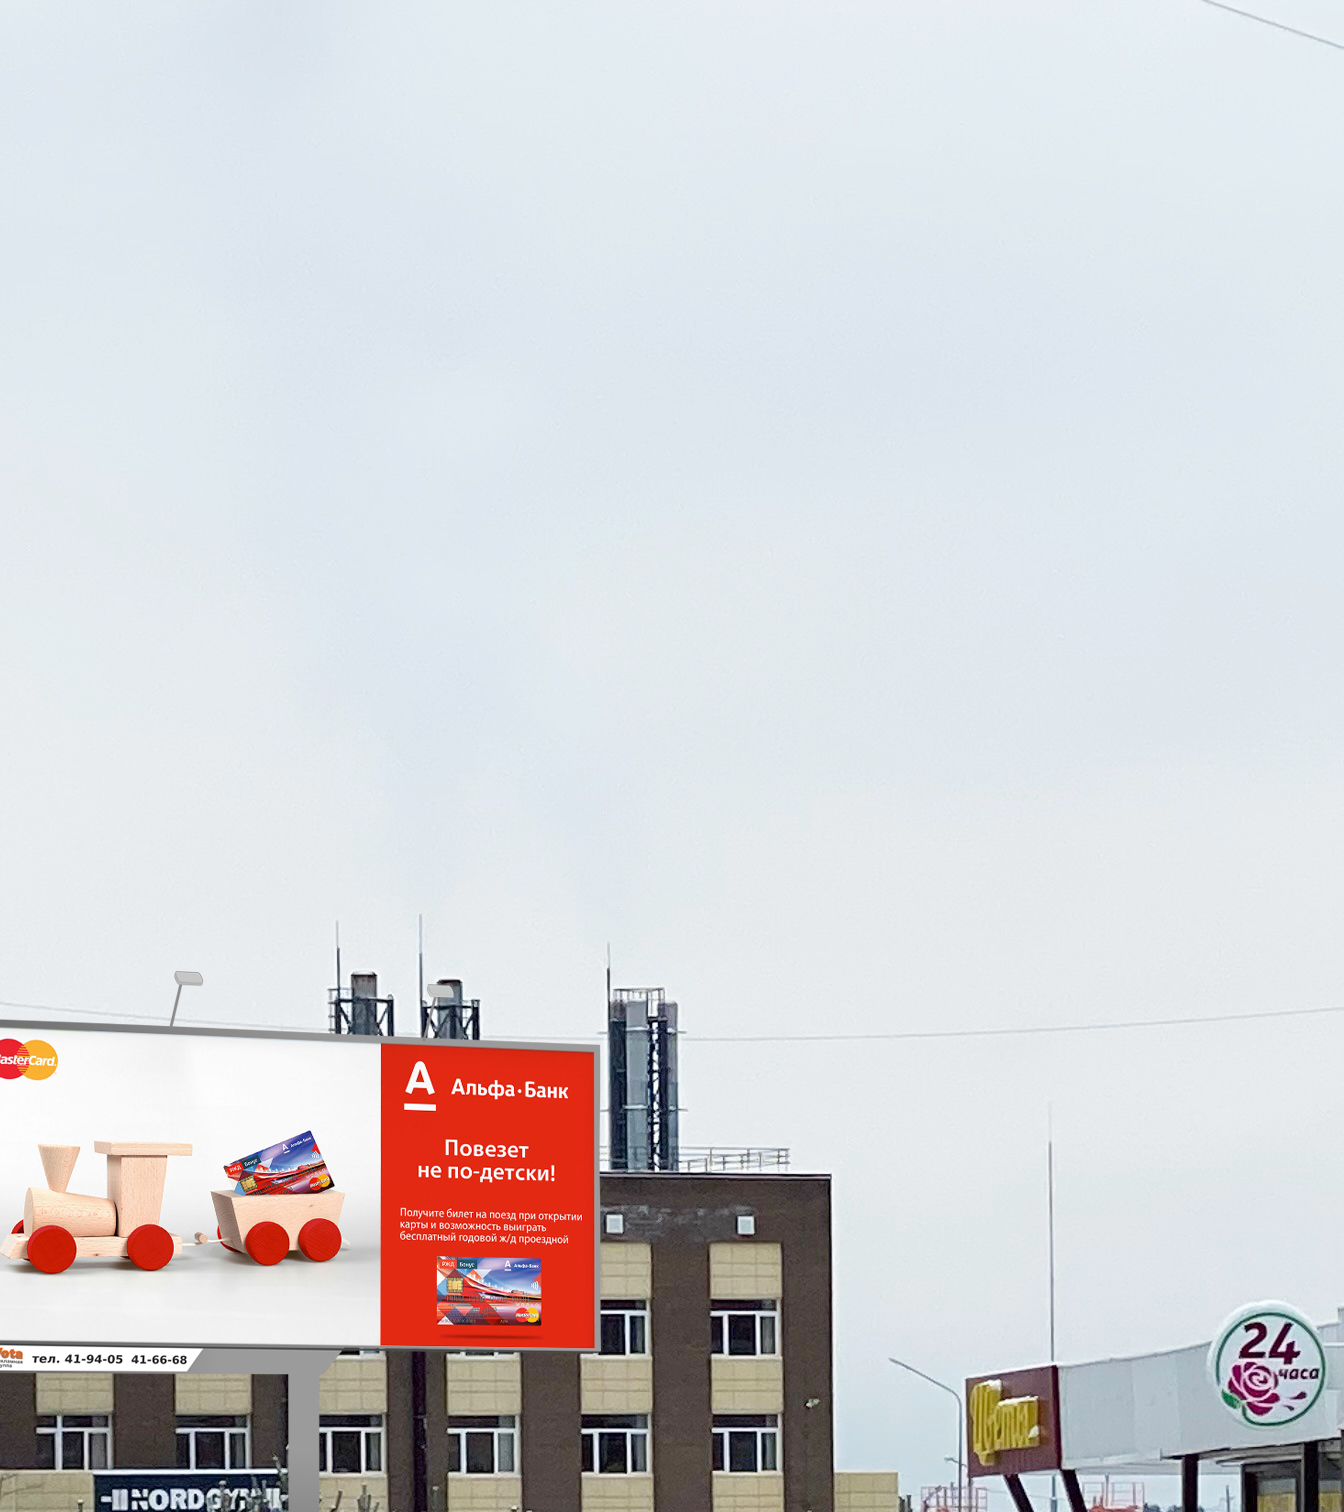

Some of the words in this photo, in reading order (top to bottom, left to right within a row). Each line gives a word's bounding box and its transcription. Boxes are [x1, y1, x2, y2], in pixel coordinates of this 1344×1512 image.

[445, 1139, 529, 1158] Повезет
[418, 1165, 442, 1178] не
[448, 1164, 556, 1183] по-детски!
[400, 1207, 445, 1220] Получите
[446, 1208, 474, 1219] билет
[475, 1211, 487, 1219] на
[489, 1212, 517, 1221] поезд
[518, 1213, 536, 1222] при
[538, 1213, 583, 1222] открытии
[400, 1221, 429, 1231] карты
[439, 1222, 502, 1231] возможность
[503, 1224, 547, 1233] выиграть
[399, 1231, 456, 1242] бесплатный
[458, 1233, 498, 1243] годовой
[499, 1234, 517, 1244] ж/д
[518, 1235, 569, 1245] проездной
[1238, 1321, 1302, 1365] 24
[32, 1354, 60, 1364] тел.
[64, 1354, 124, 1364] 41-94-05
[131, 1355, 188, 1365] 41-66-68
[1278, 1367, 1320, 1380] часа
